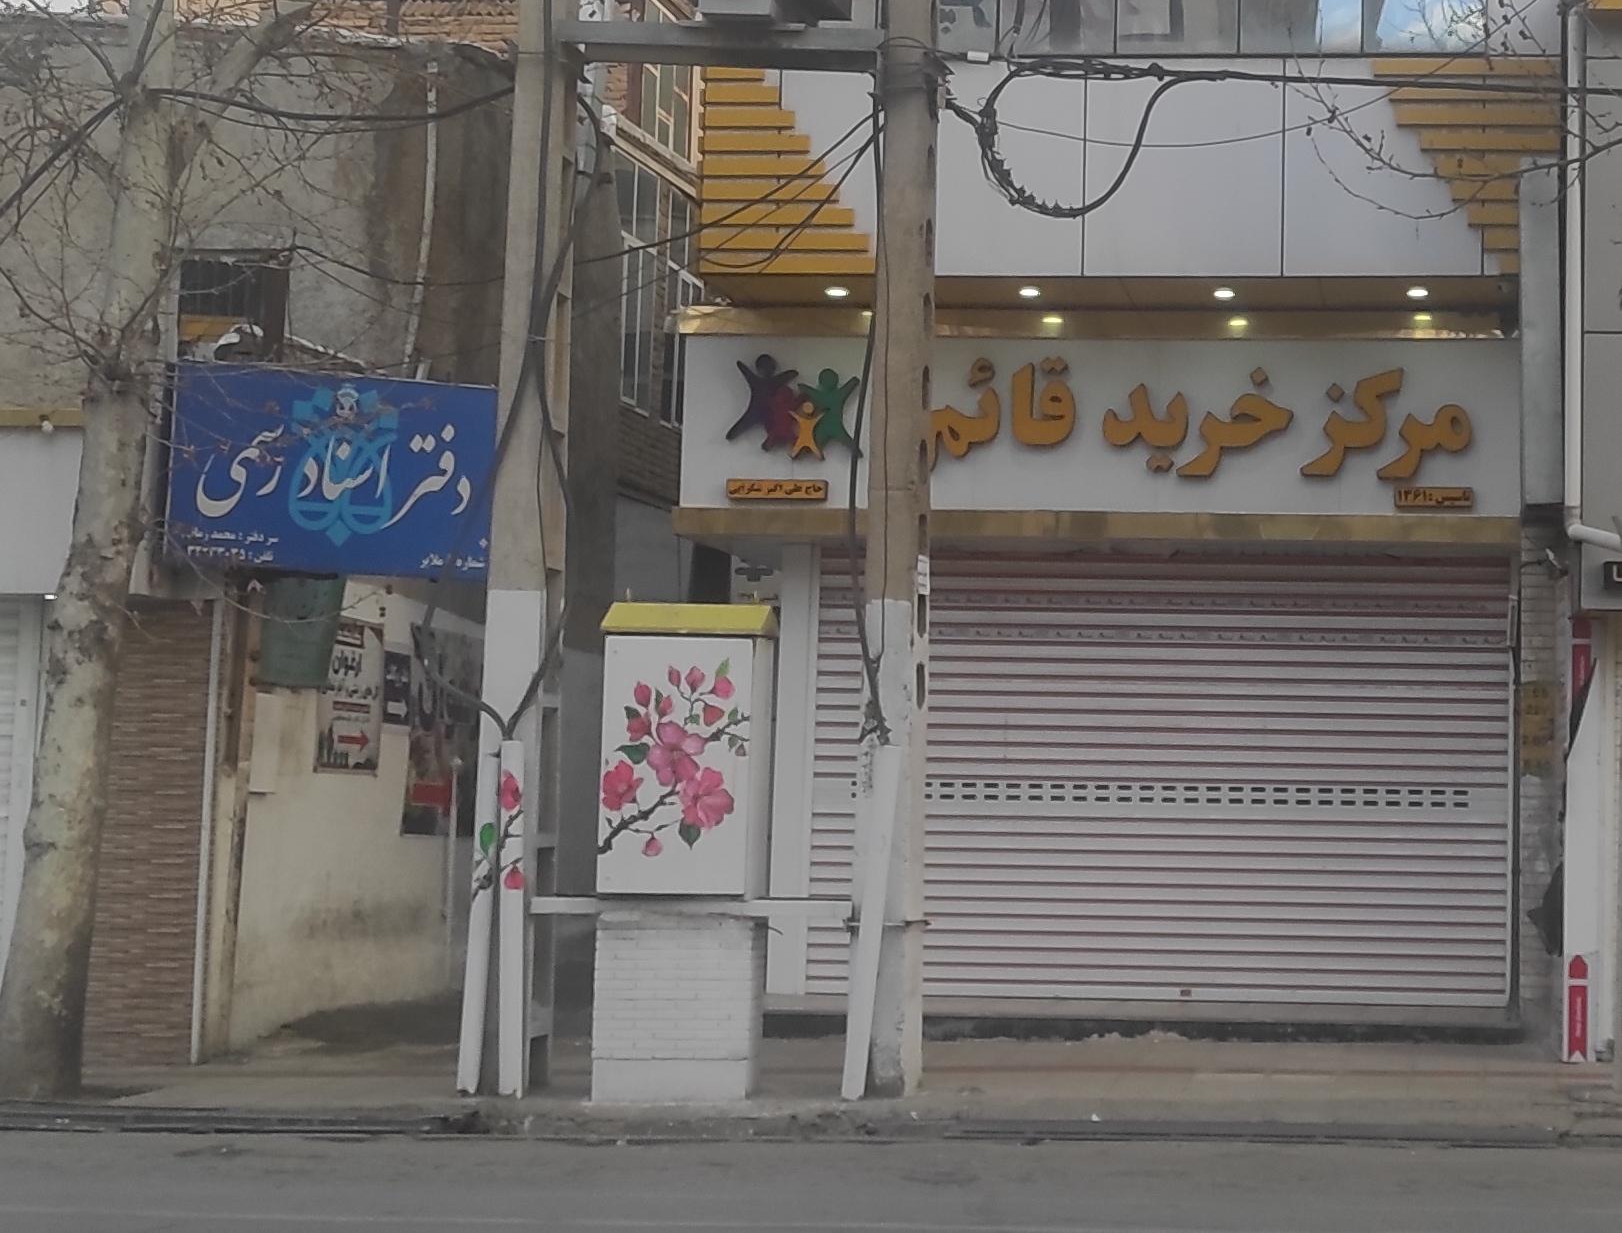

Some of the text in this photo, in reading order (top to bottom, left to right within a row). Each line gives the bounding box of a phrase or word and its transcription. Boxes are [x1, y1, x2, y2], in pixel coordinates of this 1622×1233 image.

[195, 423, 472, 529] دفتر اسناد رسمی
[1102, 366, 1294, 478] خرید
[1300, 366, 1472, 480] مرکز
